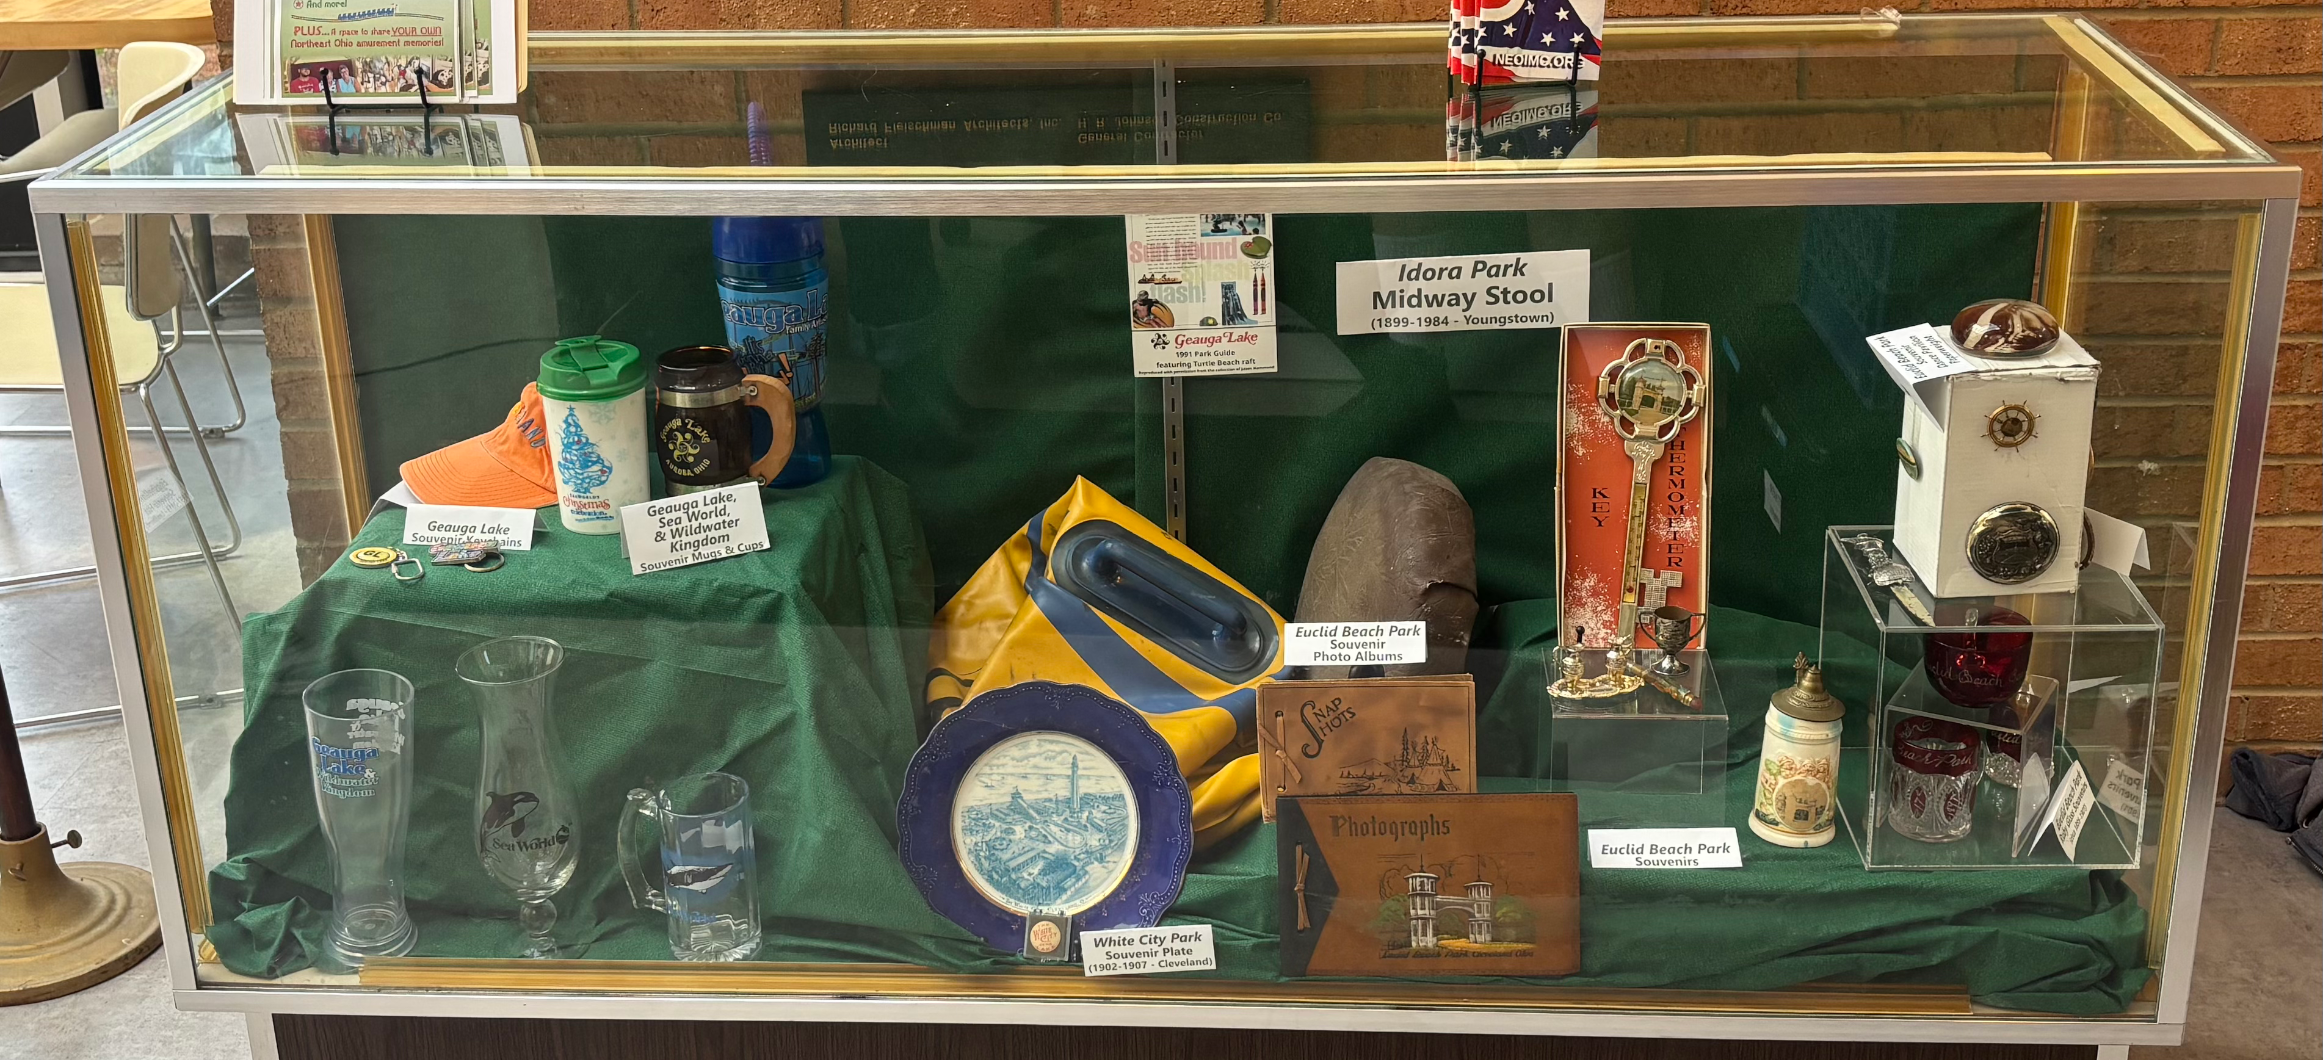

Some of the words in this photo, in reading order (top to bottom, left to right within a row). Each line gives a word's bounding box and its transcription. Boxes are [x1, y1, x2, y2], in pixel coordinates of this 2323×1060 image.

[361, 28, 368, 36] to
[371, 27, 390, 36] share
[392, 26, 418, 36] YOUR
[420, 26, 442, 36] OWN
[290, 39, 330, 48] Northeast
[334, 39, 352, 48] Ohio
[356, 40, 400, 48] amusement
[404, 38, 444, 47] memories!
[1398, 262, 1462, 282] Idora
[1471, 257, 1528, 280] Park
[1372, 288, 1477, 312] Midway
[1486, 282, 1554, 306] Stool
[720, 299, 804, 334] eauga
[1371, 315, 1450, 330] (1899-1984
[1464, 312, 1554, 326] Youngstown)
[1174, 333, 1222, 350] Geauga
[1223, 331, 1258, 346] Lake
[1156, 360, 1192, 369] featuring
[1194, 360, 1216, 368] Turtle
[1242, 358, 1256, 366] raft
[685, 418, 710, 444] Lake
[647, 498, 698, 517] Geauga
[704, 492, 736, 507] Lake,
[1591, 488, 1610, 528] KEY
[659, 516, 682, 528] Sea
[686, 505, 730, 522] World,
[428, 520, 477, 536] Geauga
[480, 523, 510, 535] Lake
[654, 531, 666, 542] &
[670, 518, 740, 540] Wildwater
[412, 532, 464, 545] Souvenir
[670, 534, 730, 554] Kingdom
[364, 550, 381, 558] GL
[640, 555, 688, 572] Souvenir
[692, 548, 722, 562] Mugs
[726, 546, 734, 554] &
[738, 540, 764, 553] Cups
[1296, 625, 1338, 638] Euclid
[1342, 624, 1384, 637] Beach
[1389, 624, 1421, 636] Park
[1330, 639, 1386, 650] Souvenir
[1314, 651, 1351, 662] Photo
[1355, 651, 1403, 662] Albums
[1958, 669, 2003, 687] Beach
[311, 736, 379, 762] Geauga
[320, 754, 366, 775] Lake
[364, 768, 377, 779] &
[322, 783, 376, 799] Kingdom
[1328, 814, 1450, 842] Photographs
[492, 838, 515, 852] Sea
[516, 836, 556, 852] World
[1601, 843, 1645, 856] Euclid
[1649, 843, 1693, 856] Beach
[1697, 842, 1731, 854] Park
[1635, 856, 1699, 867] Souvenirs
[1094, 936, 1134, 948] White
[1139, 934, 1166, 947] City
[1171, 931, 1202, 943] Park
[1106, 948, 1159, 960] Souvenir
[1163, 946, 1193, 957] Plate
[1088, 961, 1147, 973] (1902-1907
[1158, 957, 1213, 968] Cleveland)
